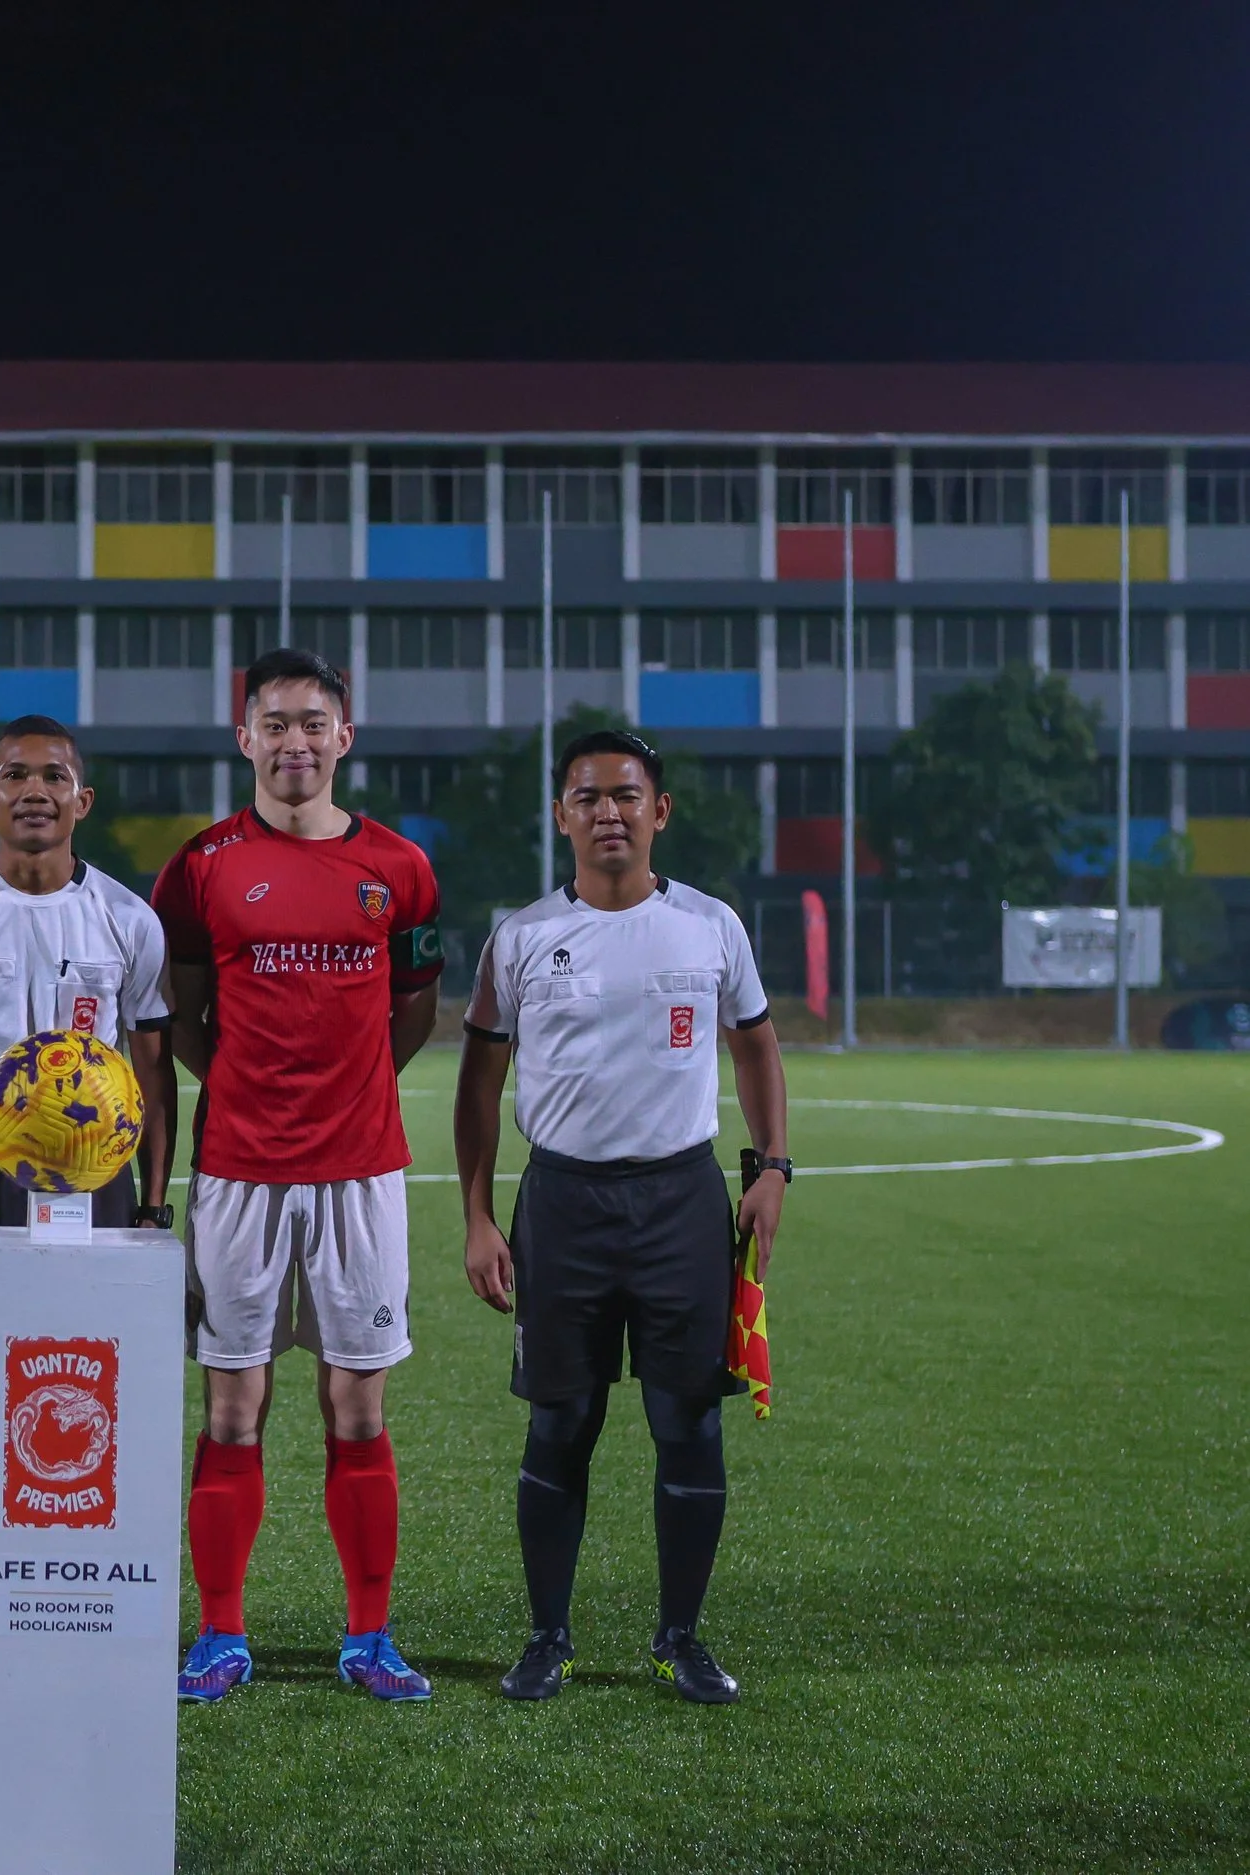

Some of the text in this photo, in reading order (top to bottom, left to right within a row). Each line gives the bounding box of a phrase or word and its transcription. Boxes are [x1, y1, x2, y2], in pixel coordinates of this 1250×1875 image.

[419, 929, 438, 957] C
[281, 960, 373, 972] HOLDINGS
[551, 968, 574, 976] MILLS
[21, 1353, 102, 1381] VANTRA
[15, 1484, 103, 1513] PREMIER
[45, 1562, 100, 1582] FOR
[107, 1563, 157, 1583] ALL
[9, 1602, 114, 1615] NO ROOM FOR
[9, 1620, 113, 1633] HOOLIGANISM
